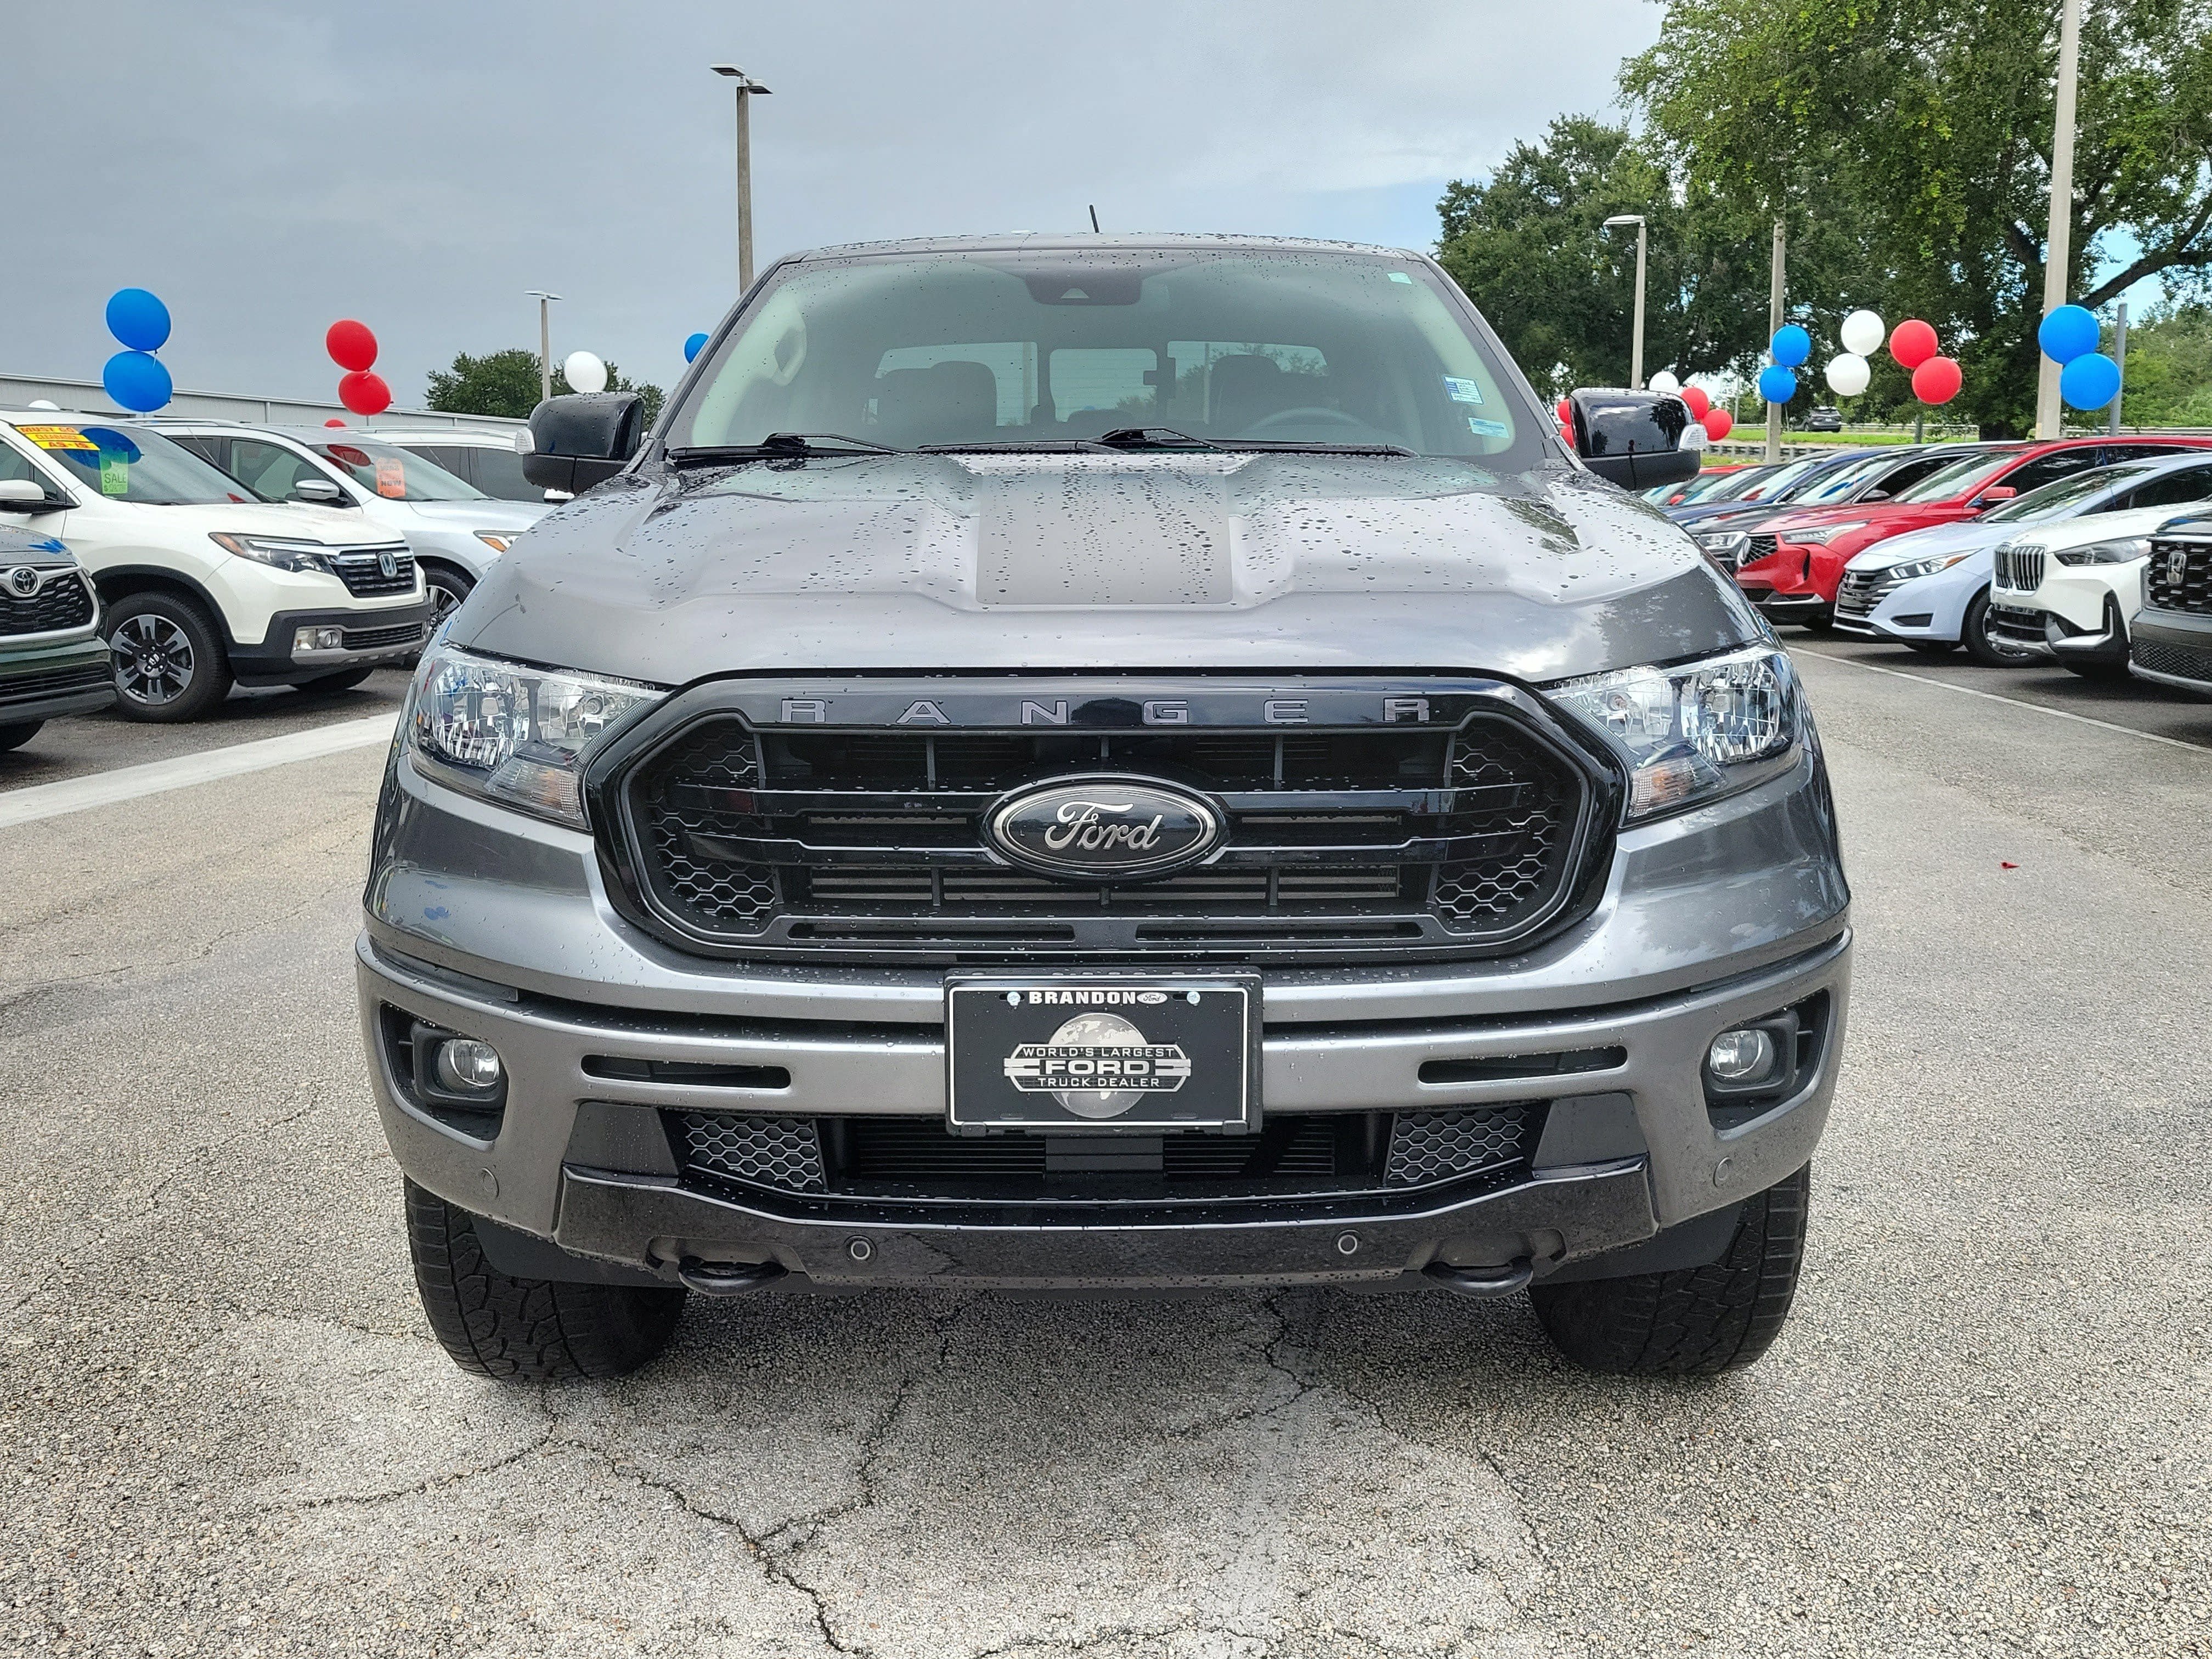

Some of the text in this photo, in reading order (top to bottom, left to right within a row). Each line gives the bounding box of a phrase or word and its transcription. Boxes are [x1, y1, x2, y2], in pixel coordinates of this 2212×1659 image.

[104, 473, 126, 484] SALE
[781, 698, 1430, 724] RANGER
[1044, 800, 1164, 850] Ford
[1029, 991, 1136, 1005] BRANDON
[1023, 1047, 1175, 1057] WORLD'S LARGEST
[1045, 1060, 1150, 1075] FORD
[1038, 1077, 1160, 1087] TRUCK DEALER
